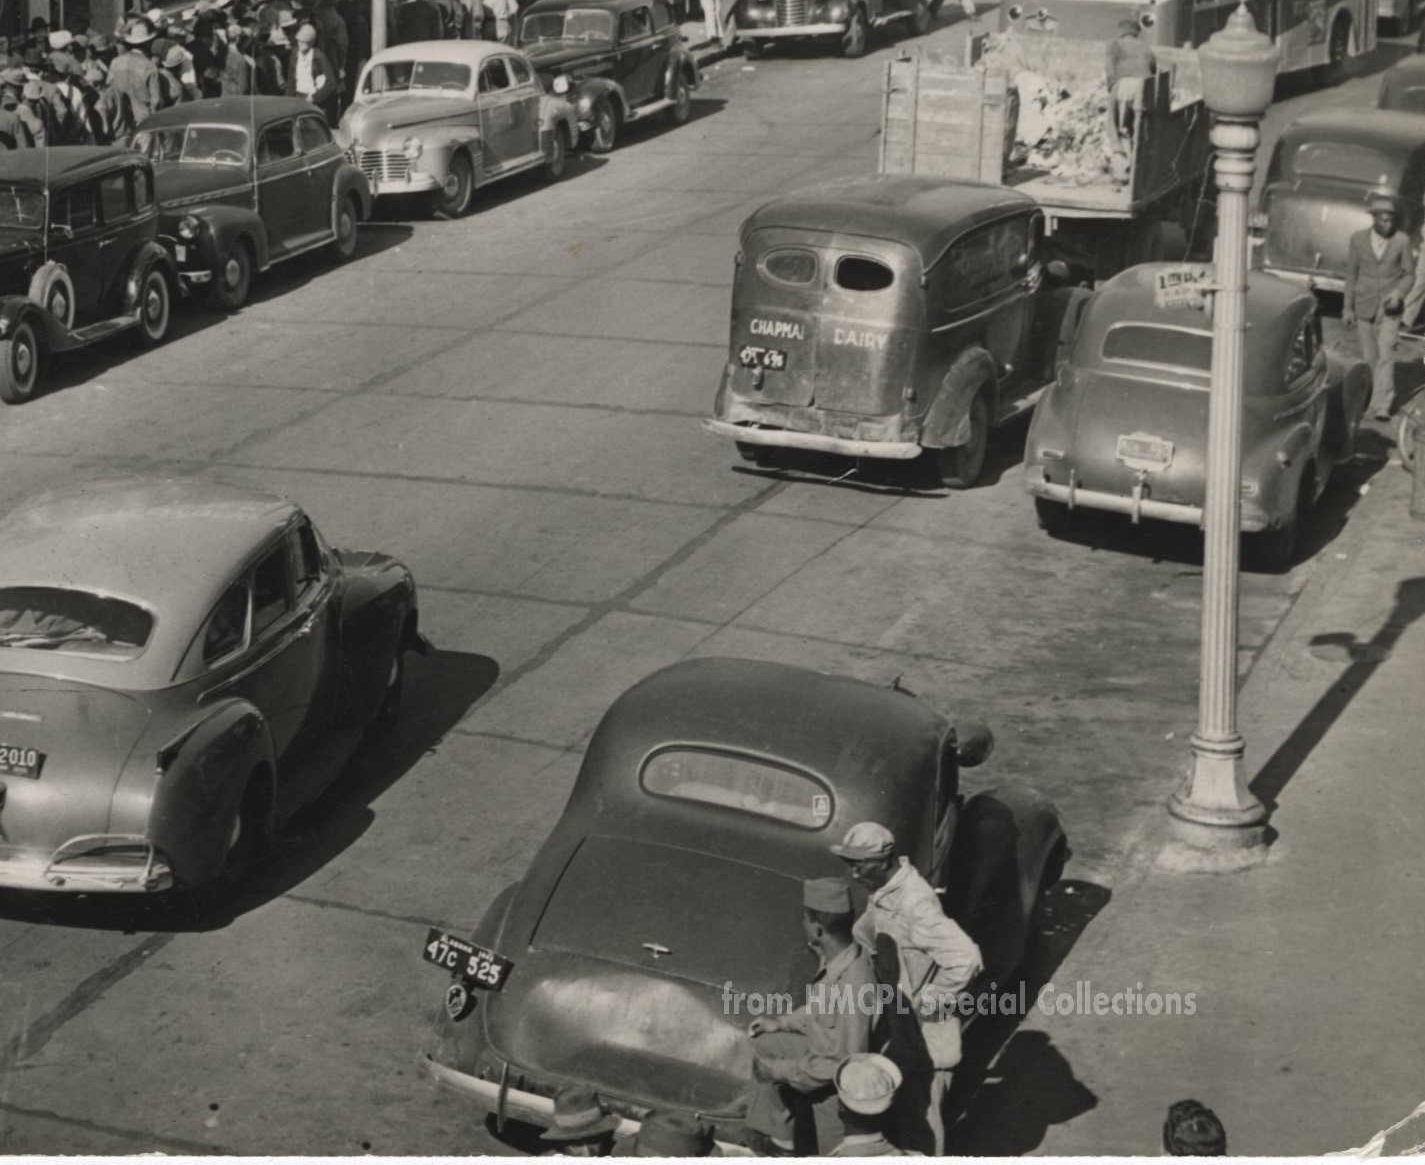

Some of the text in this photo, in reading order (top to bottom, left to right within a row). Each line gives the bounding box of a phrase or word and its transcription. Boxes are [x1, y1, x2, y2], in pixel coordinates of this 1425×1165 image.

[833, 328, 889, 350] DAIRY
[427, 940, 502, 984] 47C 525
